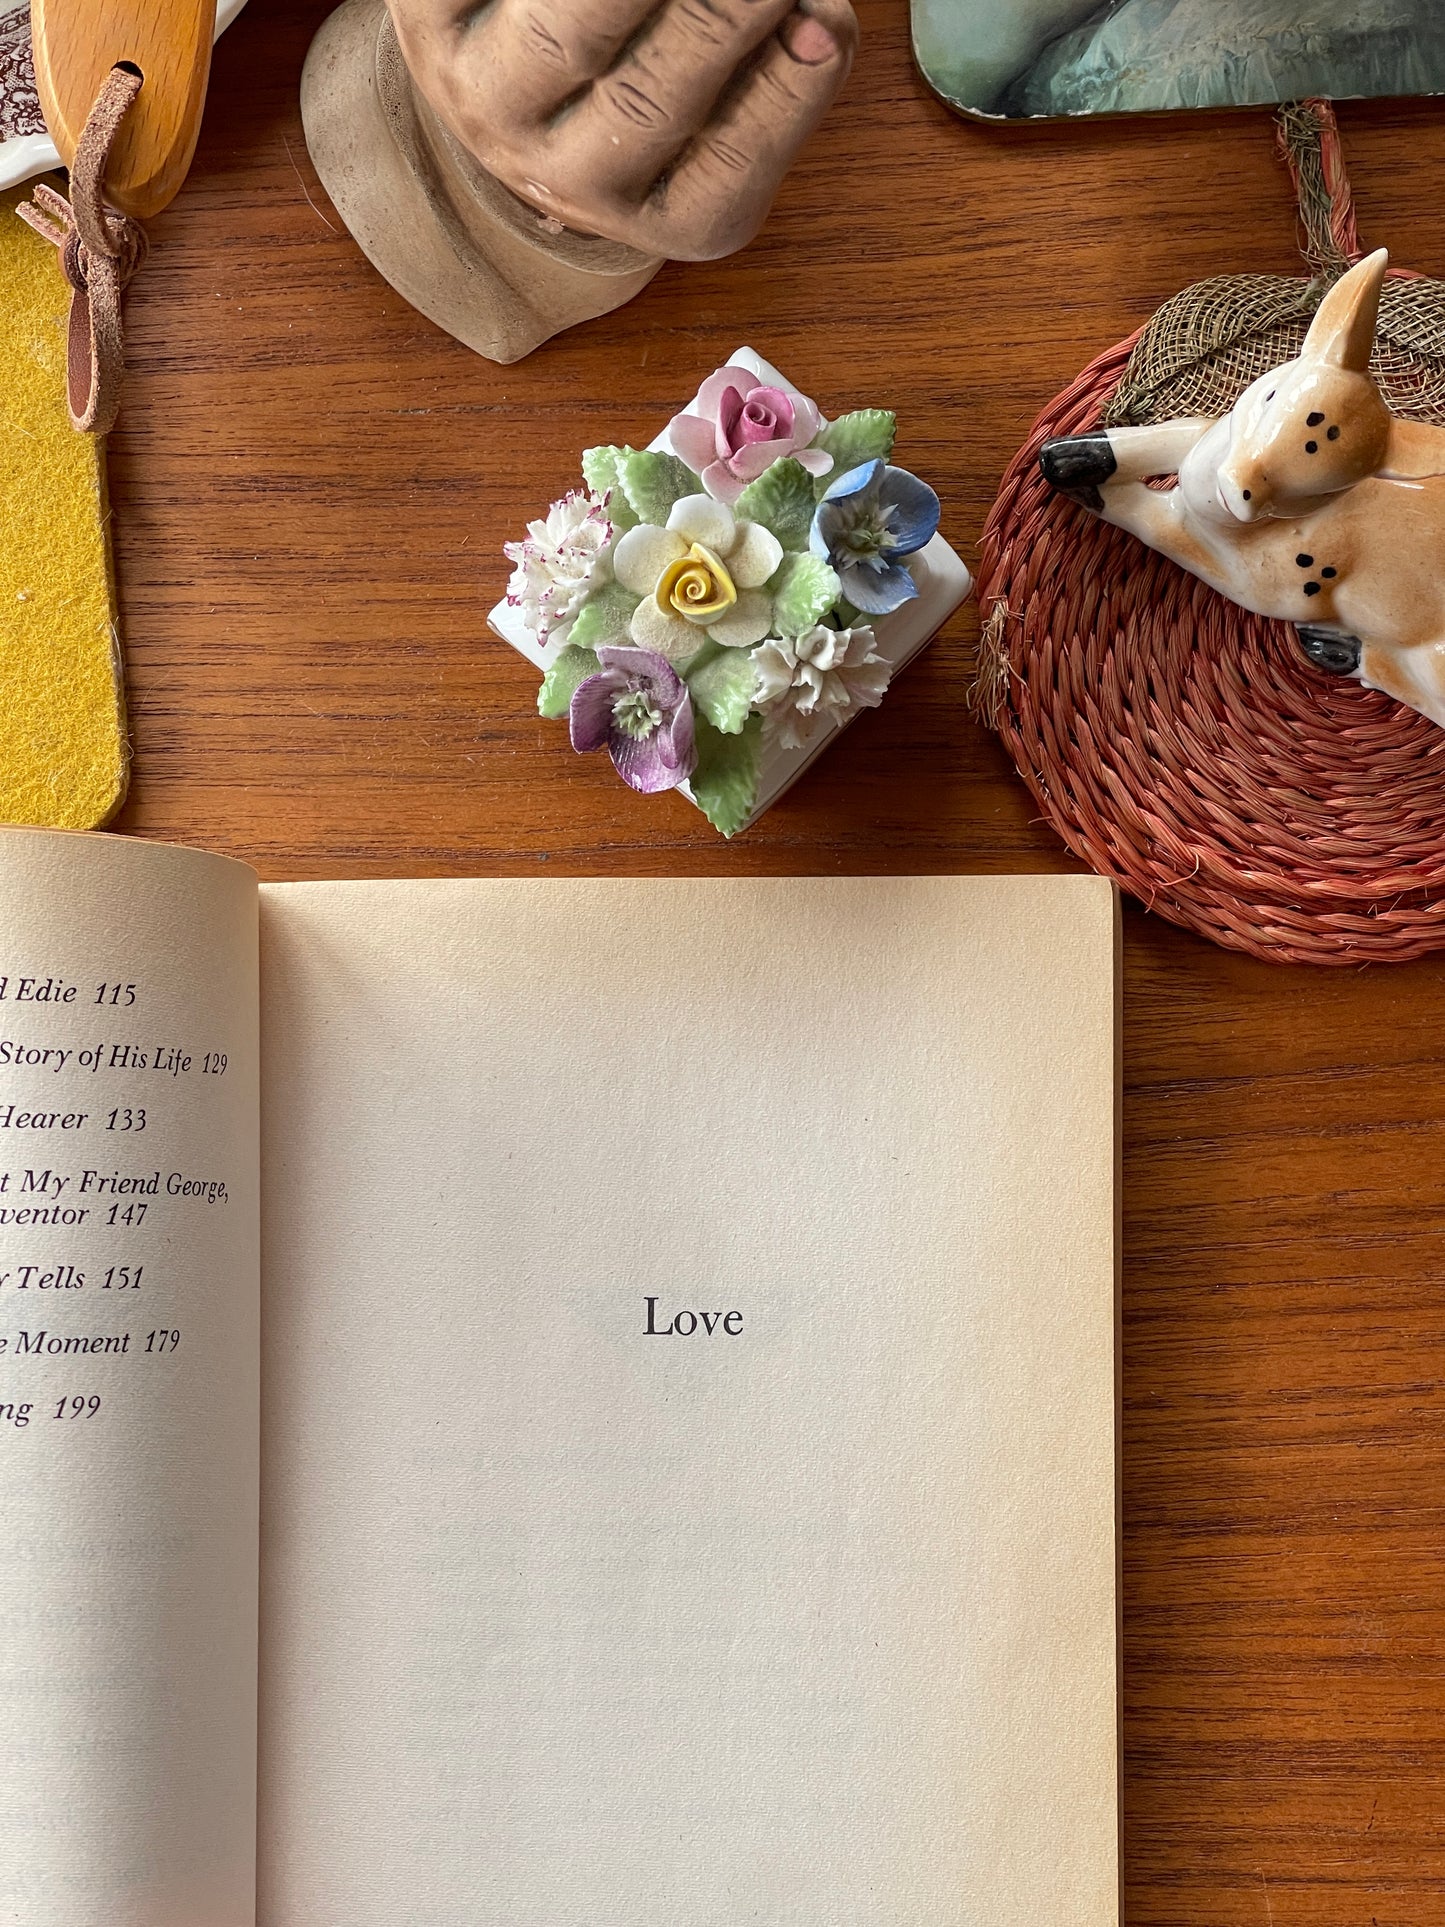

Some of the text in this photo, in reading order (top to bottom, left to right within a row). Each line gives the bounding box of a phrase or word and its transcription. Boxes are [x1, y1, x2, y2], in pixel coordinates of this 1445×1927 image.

[15, 978, 78, 1002] Edie
[94, 982, 137, 1006] 115
[0, 1041, 228, 1077] Story of His Life 129
[0, 1105, 147, 1131] Hearer 133
[20, 1169, 71, 1199] My
[79, 1170, 161, 1195] Friend
[167, 1172, 229, 1204] George,
[0, 1203, 148, 1226] ventor 147
[18, 1265, 86, 1289] Tells
[102, 1266, 144, 1289] 151
[643, 1296, 744, 1336] Love
[15, 1330, 131, 1354] Moment
[144, 1329, 181, 1353] 179
[53, 1395, 101, 1419] 199
